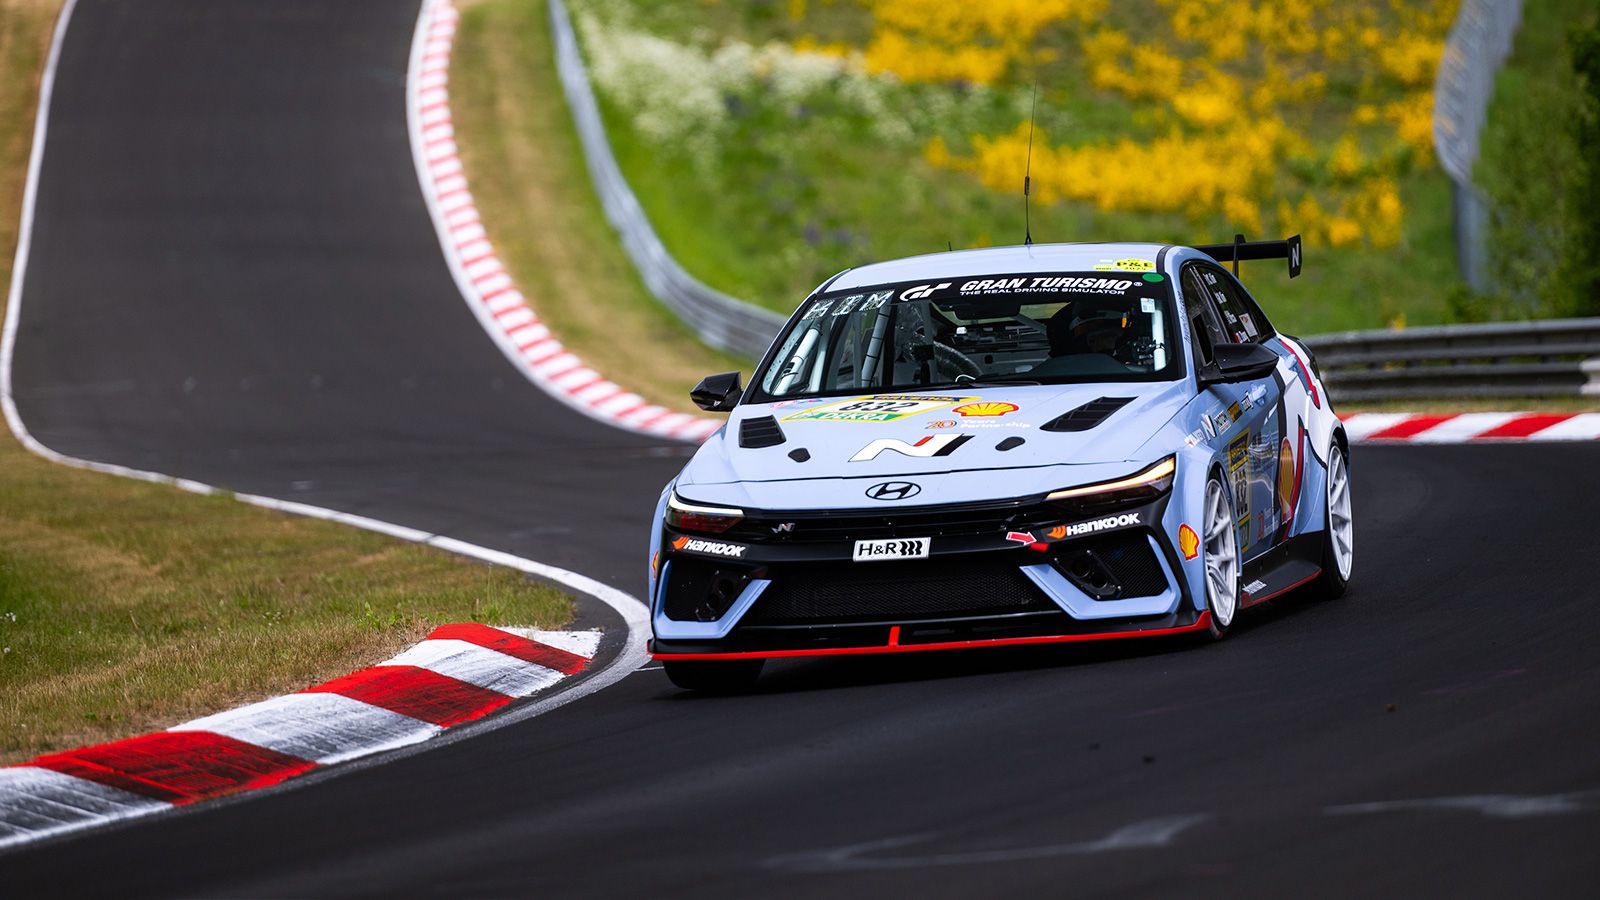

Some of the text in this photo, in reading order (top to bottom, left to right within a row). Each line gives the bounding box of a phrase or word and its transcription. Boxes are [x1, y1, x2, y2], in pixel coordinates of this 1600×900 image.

[1292, 243, 1300, 268] N
[960, 278, 1027, 291] GRAN
[1061, 287, 1125, 295] SIMULATOR
[838, 401, 920, 412] 832
[819, 412, 888, 421] DEKRA
[858, 542, 897, 556] H&R
